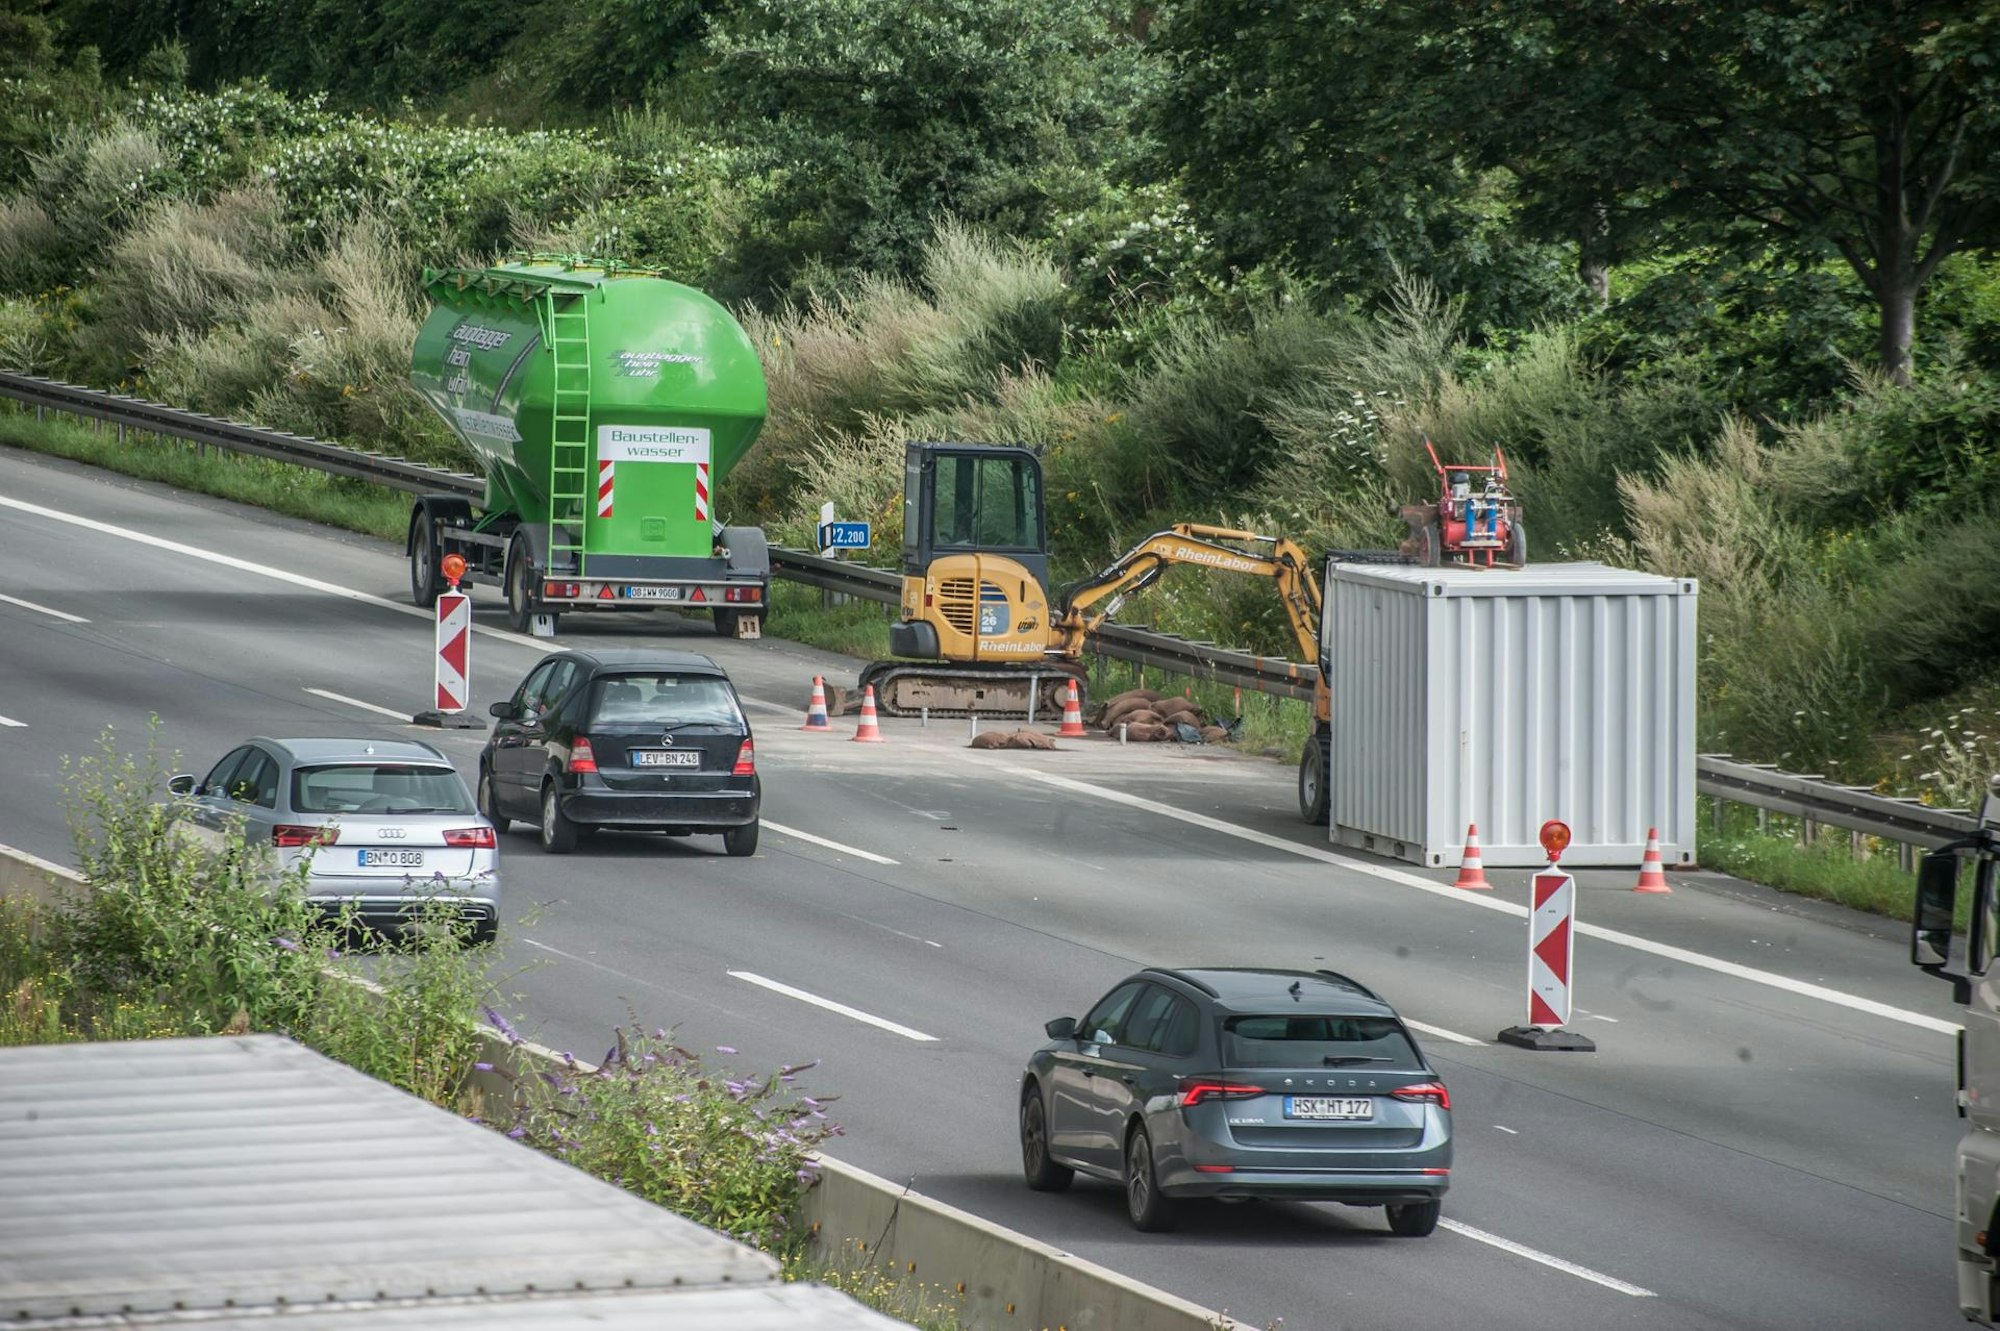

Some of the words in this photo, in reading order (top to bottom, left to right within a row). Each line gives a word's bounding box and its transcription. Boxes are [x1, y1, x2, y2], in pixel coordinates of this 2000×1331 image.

[612, 430, 699, 444] Baustellen-
[627, 447, 685, 457] wasser
[1175, 547, 1257, 571] RheinLabor
[981, 608, 995, 616] PC
[981, 616, 997, 626] 26
[640, 753, 659, 764] LEV
[665, 753, 678, 764] BN
[366, 852, 382, 863] BN
[400, 852, 422, 864] 808
[1294, 1099, 1318, 1113] HSK
[1327, 1099, 1344, 1114] HT
[1346, 1100, 1370, 1114] 177
